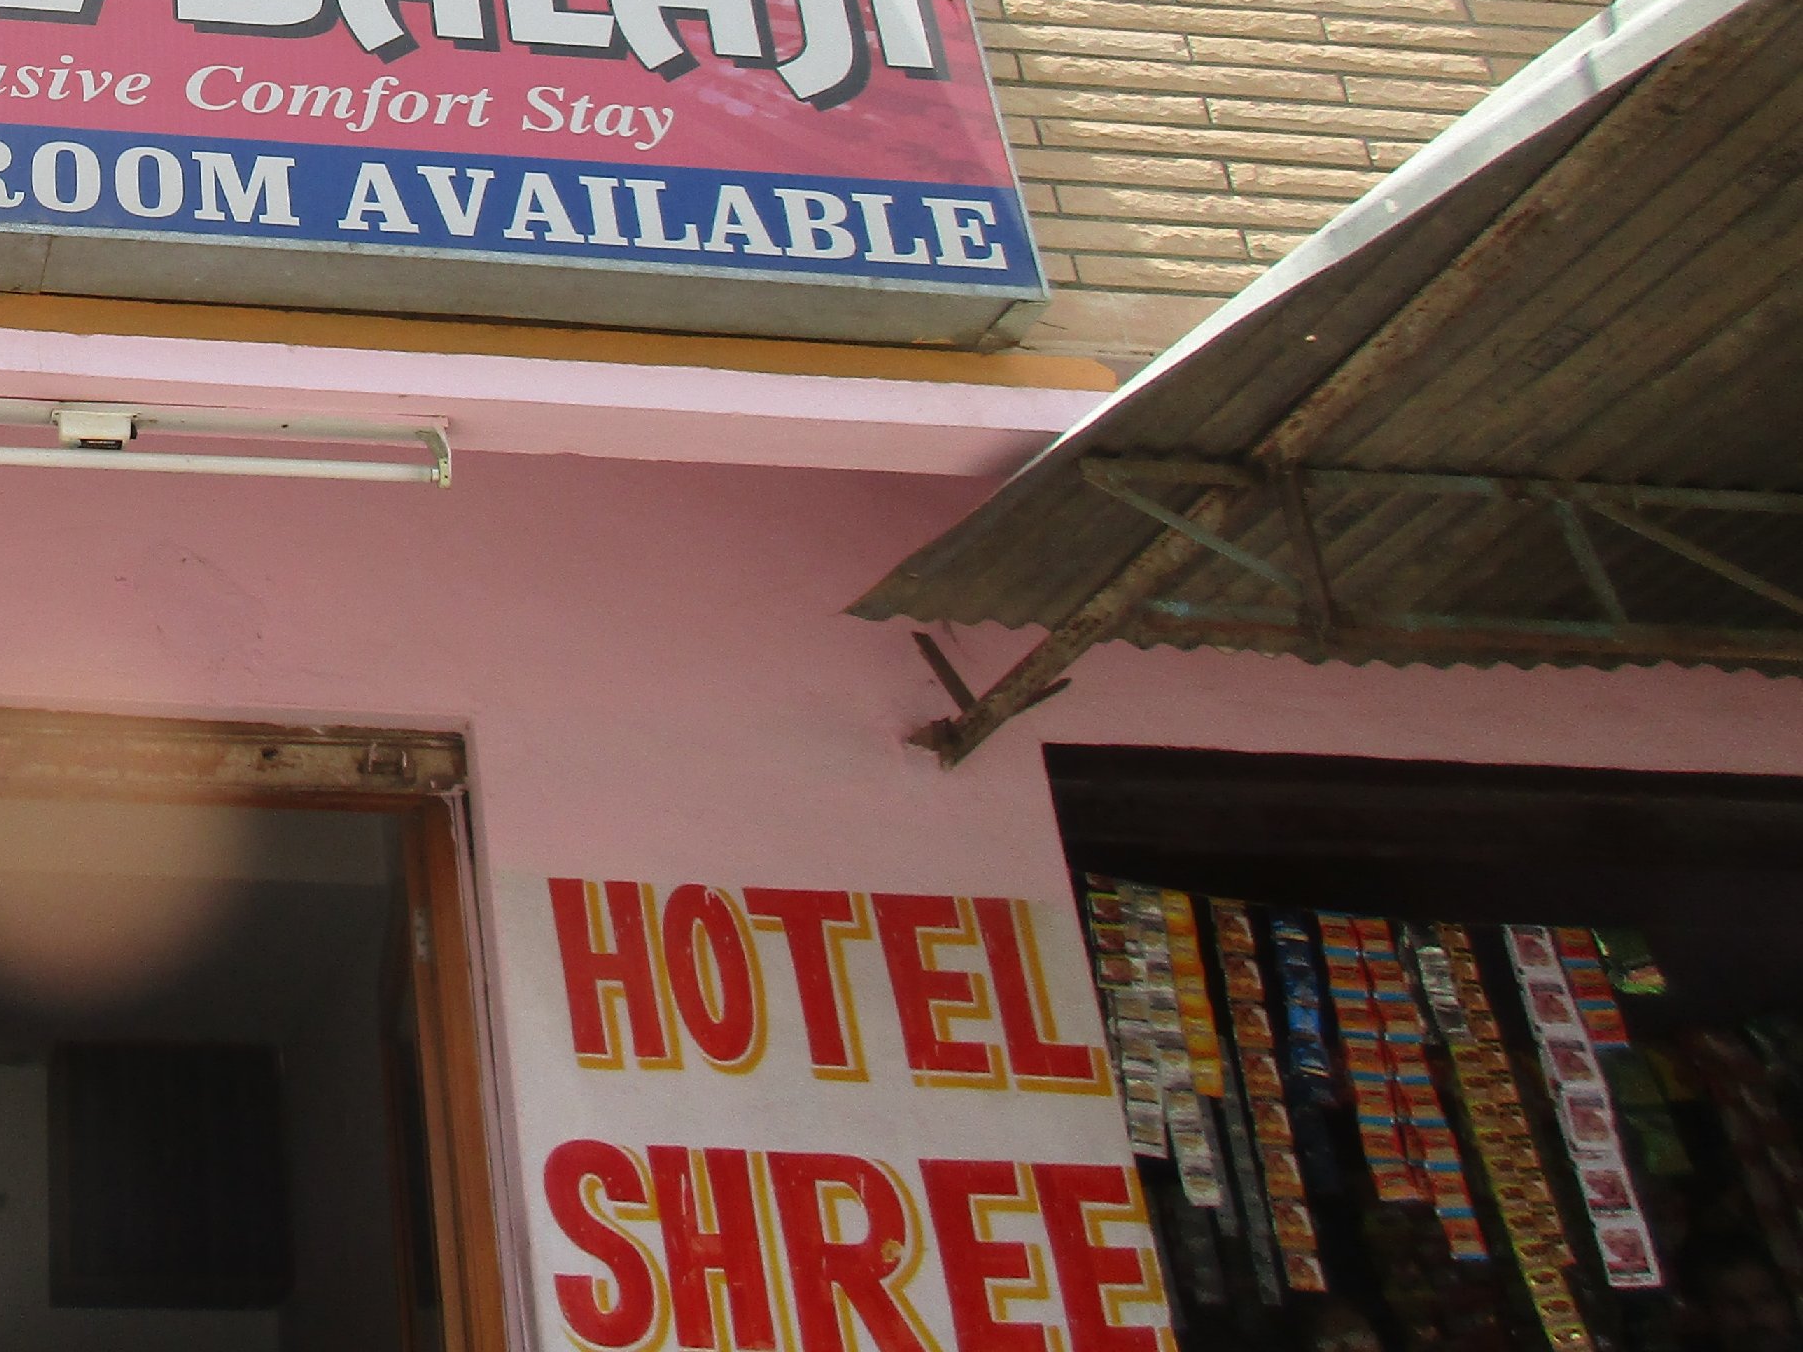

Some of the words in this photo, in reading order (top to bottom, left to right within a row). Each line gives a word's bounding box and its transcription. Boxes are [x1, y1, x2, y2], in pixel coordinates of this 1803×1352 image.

[183, 64, 495, 133] Comfort
[522, 84, 675, 152] Stay
[337, 159, 1007, 274] AVAILABLE
[547, 877, 1113, 1097] HOTEL
[543, 1138, 1178, 1352] SHREE
